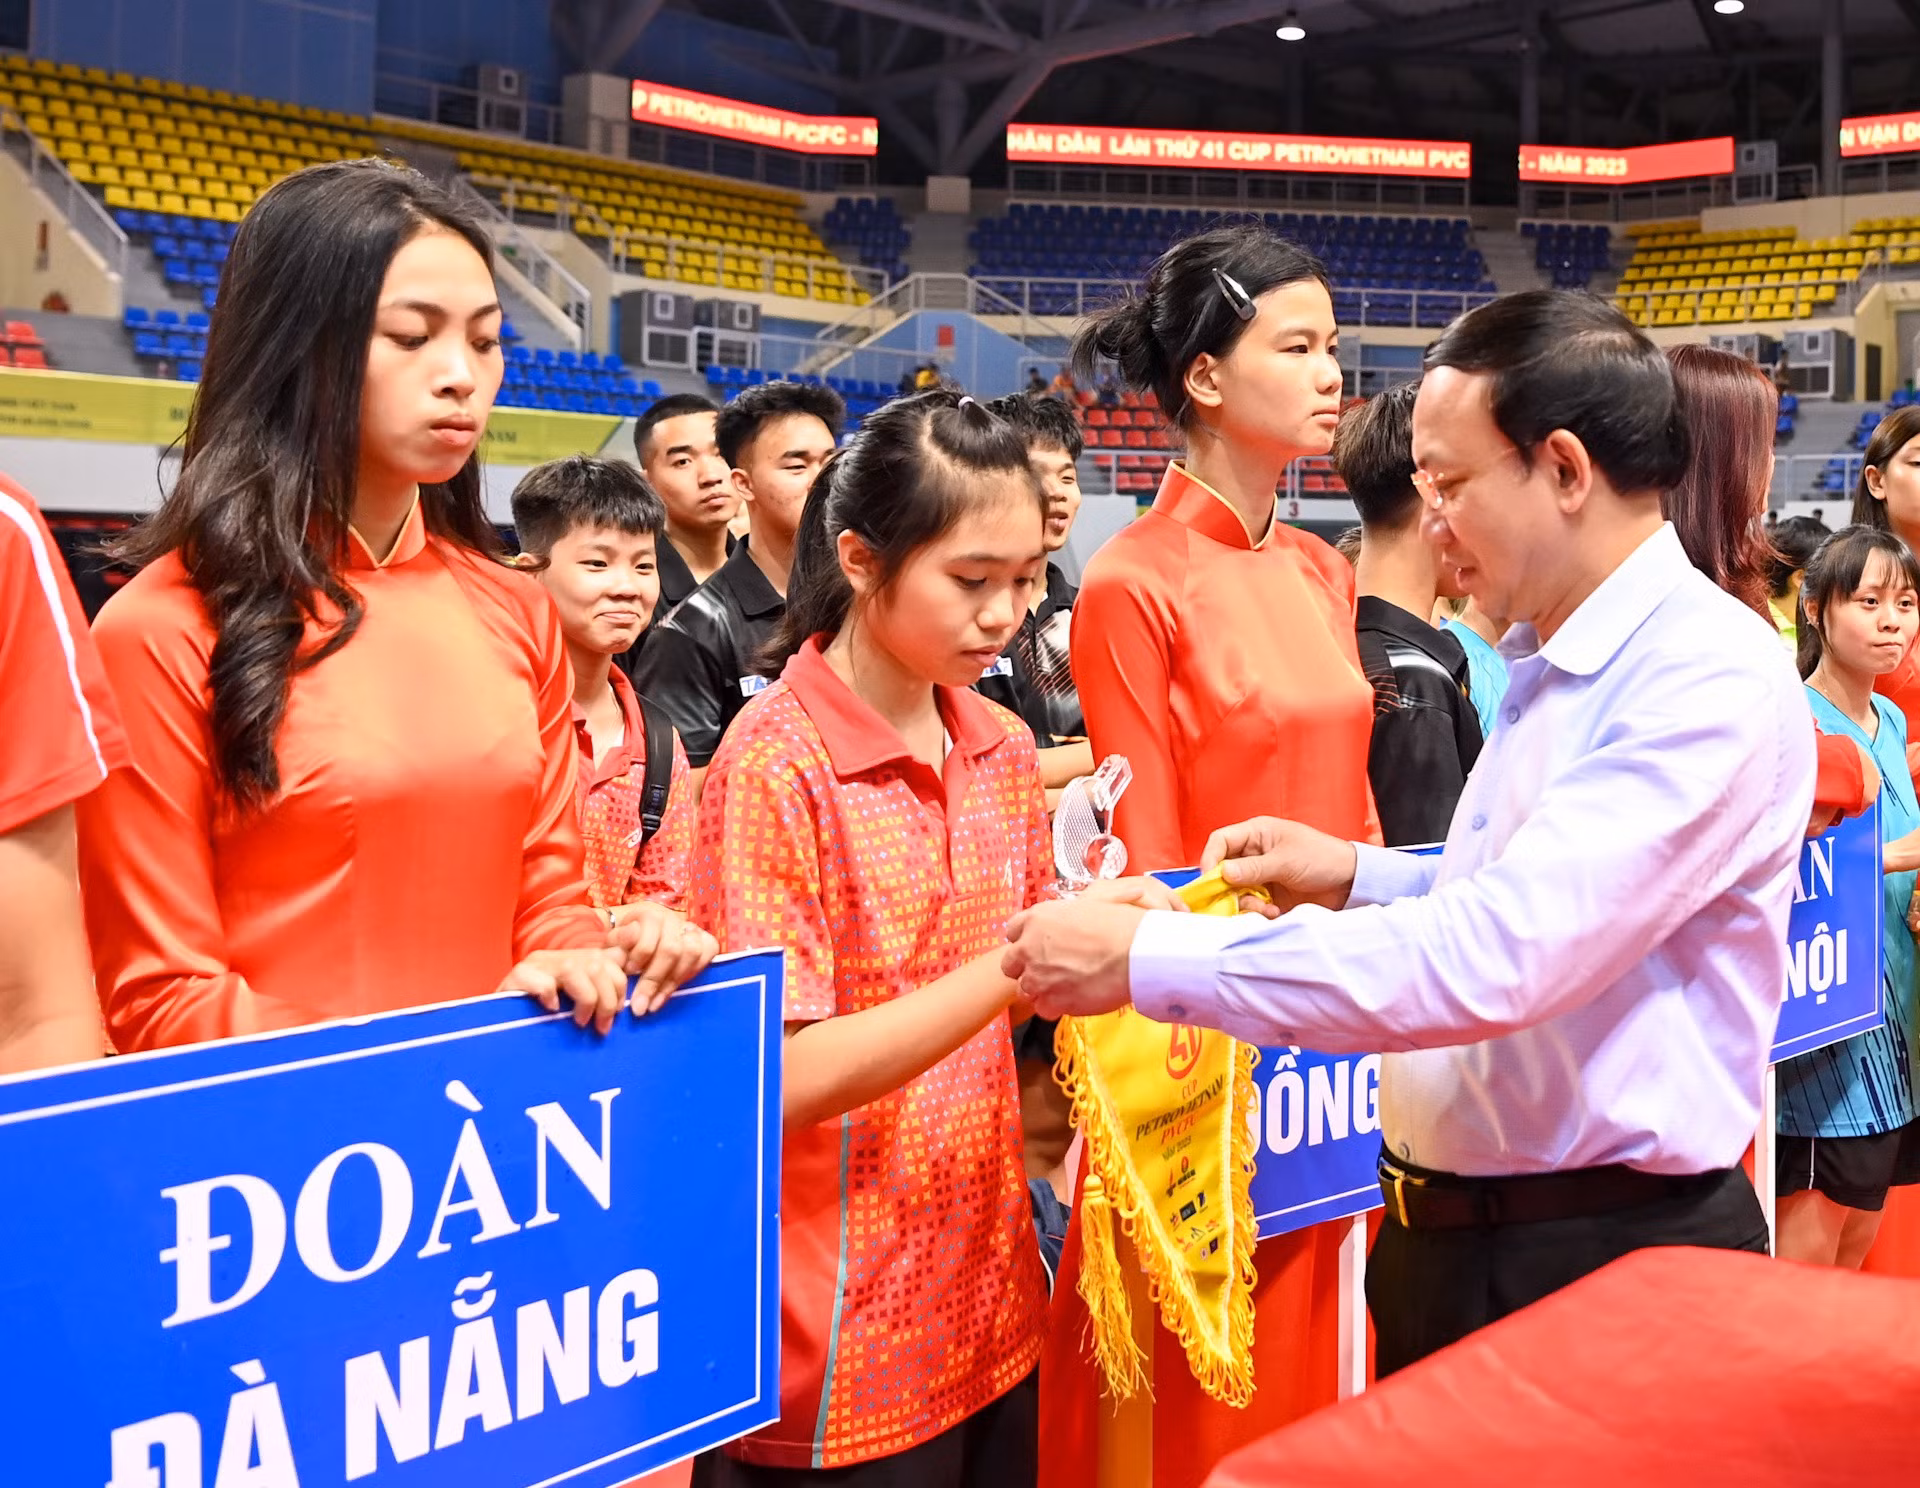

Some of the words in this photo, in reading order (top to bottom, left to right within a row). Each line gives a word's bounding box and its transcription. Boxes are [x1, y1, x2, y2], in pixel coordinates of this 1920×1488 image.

[648, 92, 781, 138] PETROVIETNAM
[1202, 140, 1224, 160] 41
[1228, 140, 1272, 161] CUP
[1274, 142, 1426, 168] PETROVIETNAM
[1429, 150, 1470, 169] PVC
[1584, 155, 1627, 176] 2023
[1288, 502, 1299, 518] 3
[1783, 921, 1848, 1005] NỘI
[1135, 1073, 1224, 1142] PETROVIETNAM
[160, 1080, 622, 1328] ĐOÀN
[105, 1359, 301, 1488] ĐÀ
[345, 1268, 660, 1482] NẴNG
